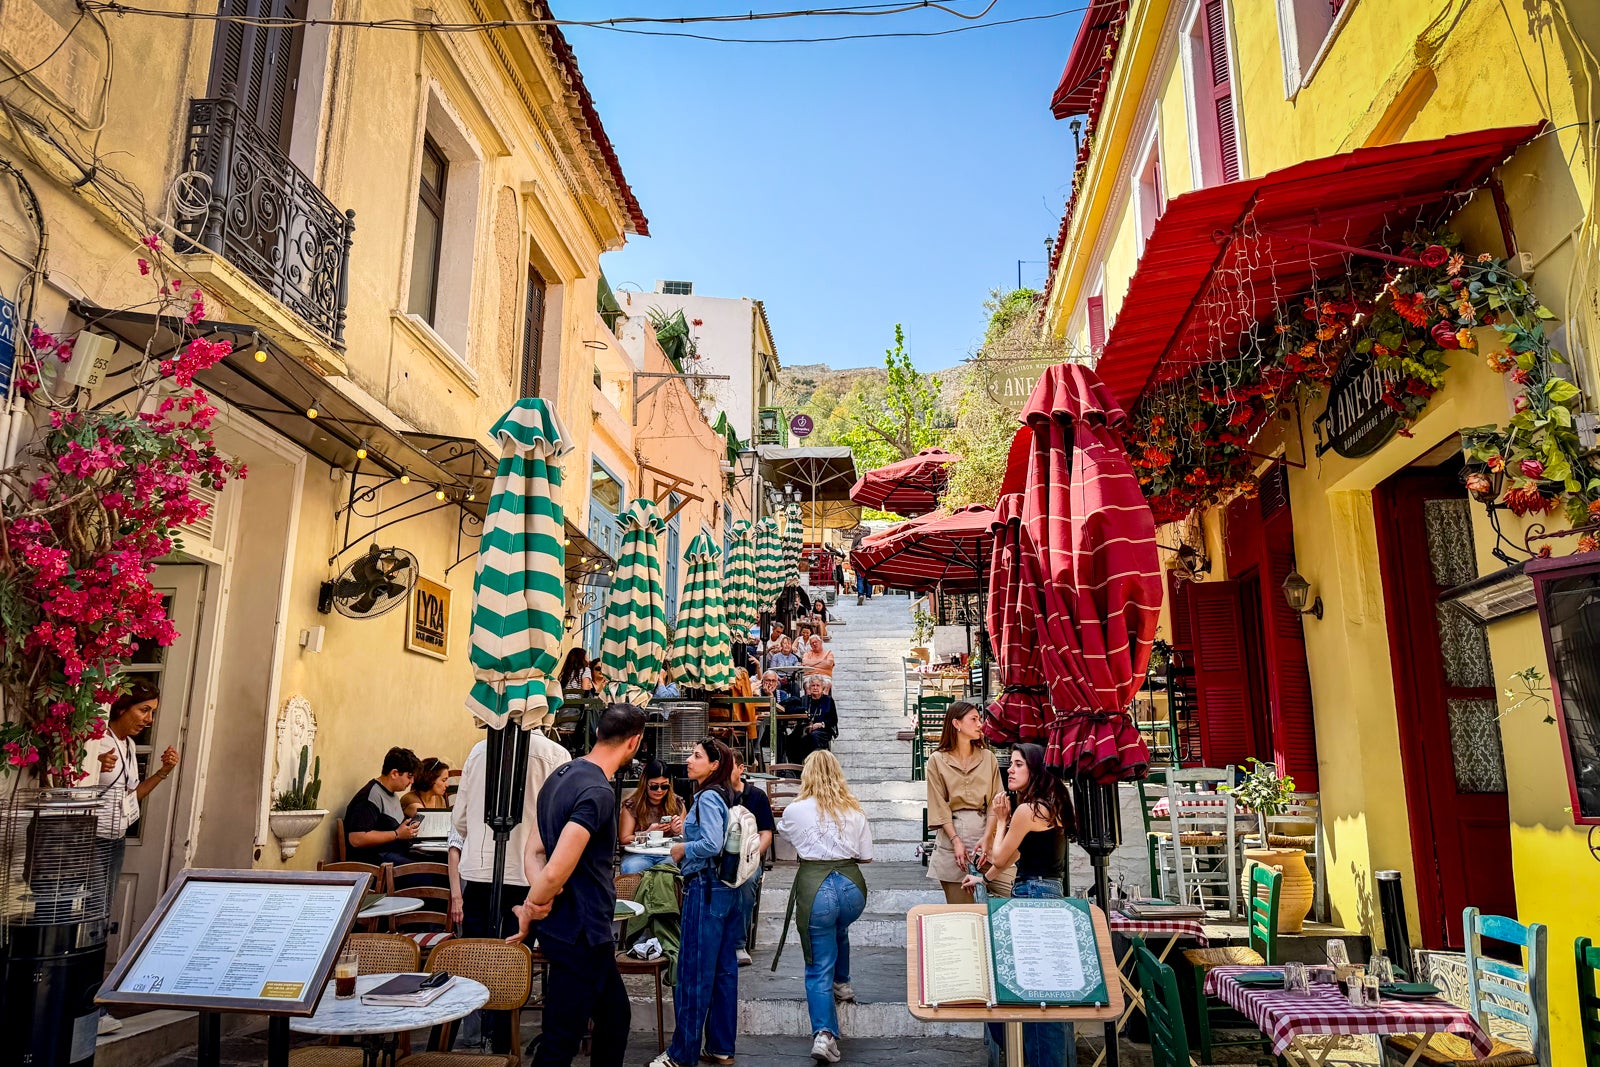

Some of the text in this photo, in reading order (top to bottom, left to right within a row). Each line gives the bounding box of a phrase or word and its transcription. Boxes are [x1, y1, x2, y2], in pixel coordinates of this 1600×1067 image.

[93, 358, 109, 370] 253
[87, 375, 98, 385] 23
[1004, 377, 1037, 396] ΑΝΕ
[416, 589, 444, 633] LYRA
[1028, 990, 1075, 999] BREAKFAST
